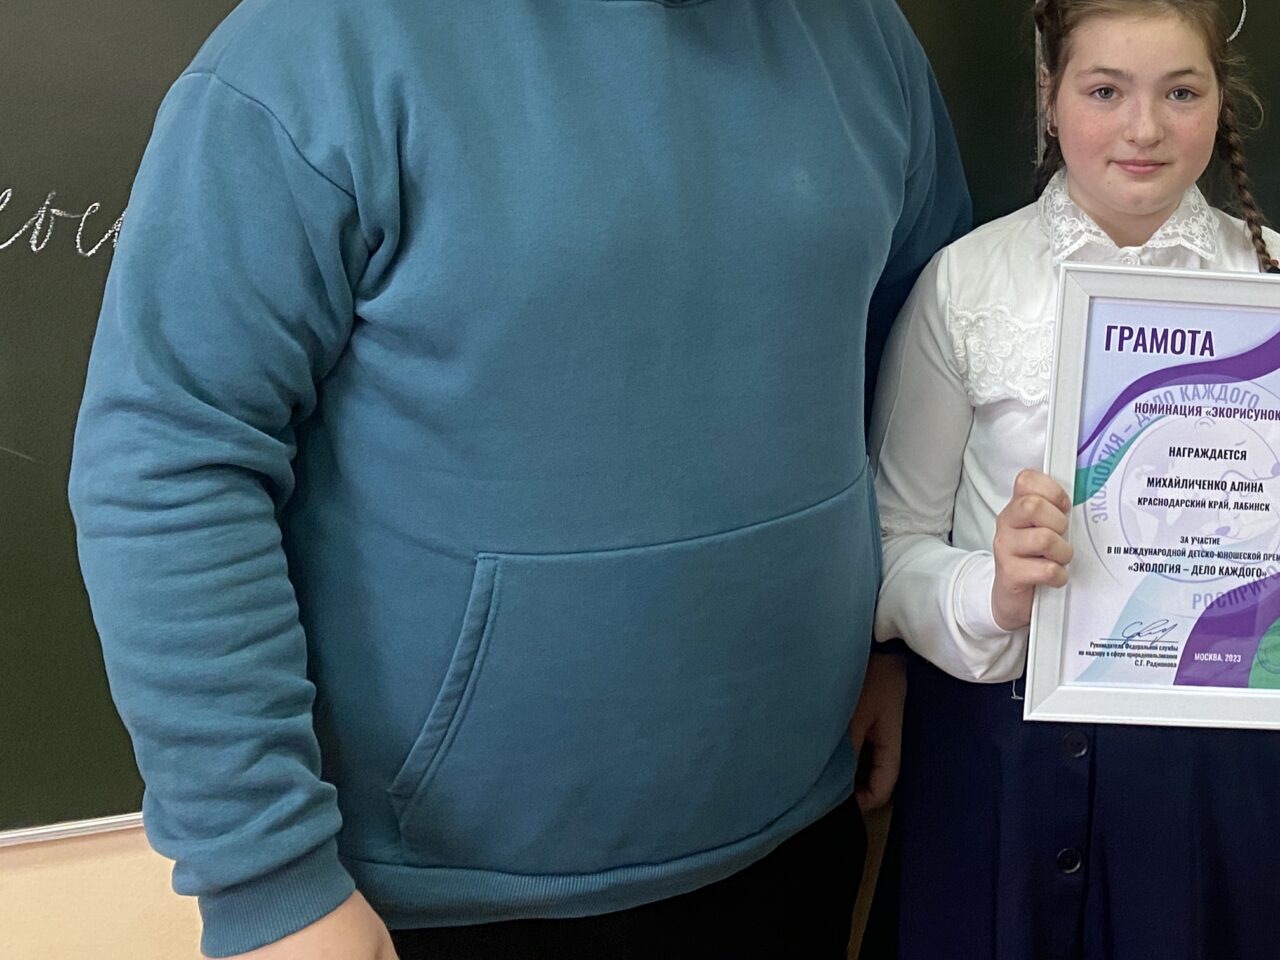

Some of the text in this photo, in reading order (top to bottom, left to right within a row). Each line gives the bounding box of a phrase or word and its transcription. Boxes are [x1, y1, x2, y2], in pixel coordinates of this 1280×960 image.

[1105, 325, 1215, 357] ГРАМОТА
[1180, 383, 1260, 408] КАЖДОГО
[1134, 402, 1201, 417] НОМИНАЦИЯ
[1169, 447, 1247, 461] НАГРАЖДАЕТСЯ
[1147, 476, 1264, 493] МИХАЙЛИЧЕНКО АЛИНА
[1137, 496, 1270, 512] КРАСНОДАРСКИЙ КРАЙ, ЛАБИНСК
[1180, 535, 1220, 545] ЗА УЧАСТИЕ
[1123, 546, 1186, 557] МЕЖДУНАРОДНОЙ
[1128, 562, 1181, 574] «ЭКОЛОГИЯ
[1191, 564, 1216, 576] ДЕЛО
[1218, 566, 1267, 578] КАЖДОГО»
[1194, 653, 1242, 663] МОСКВА, 2023
